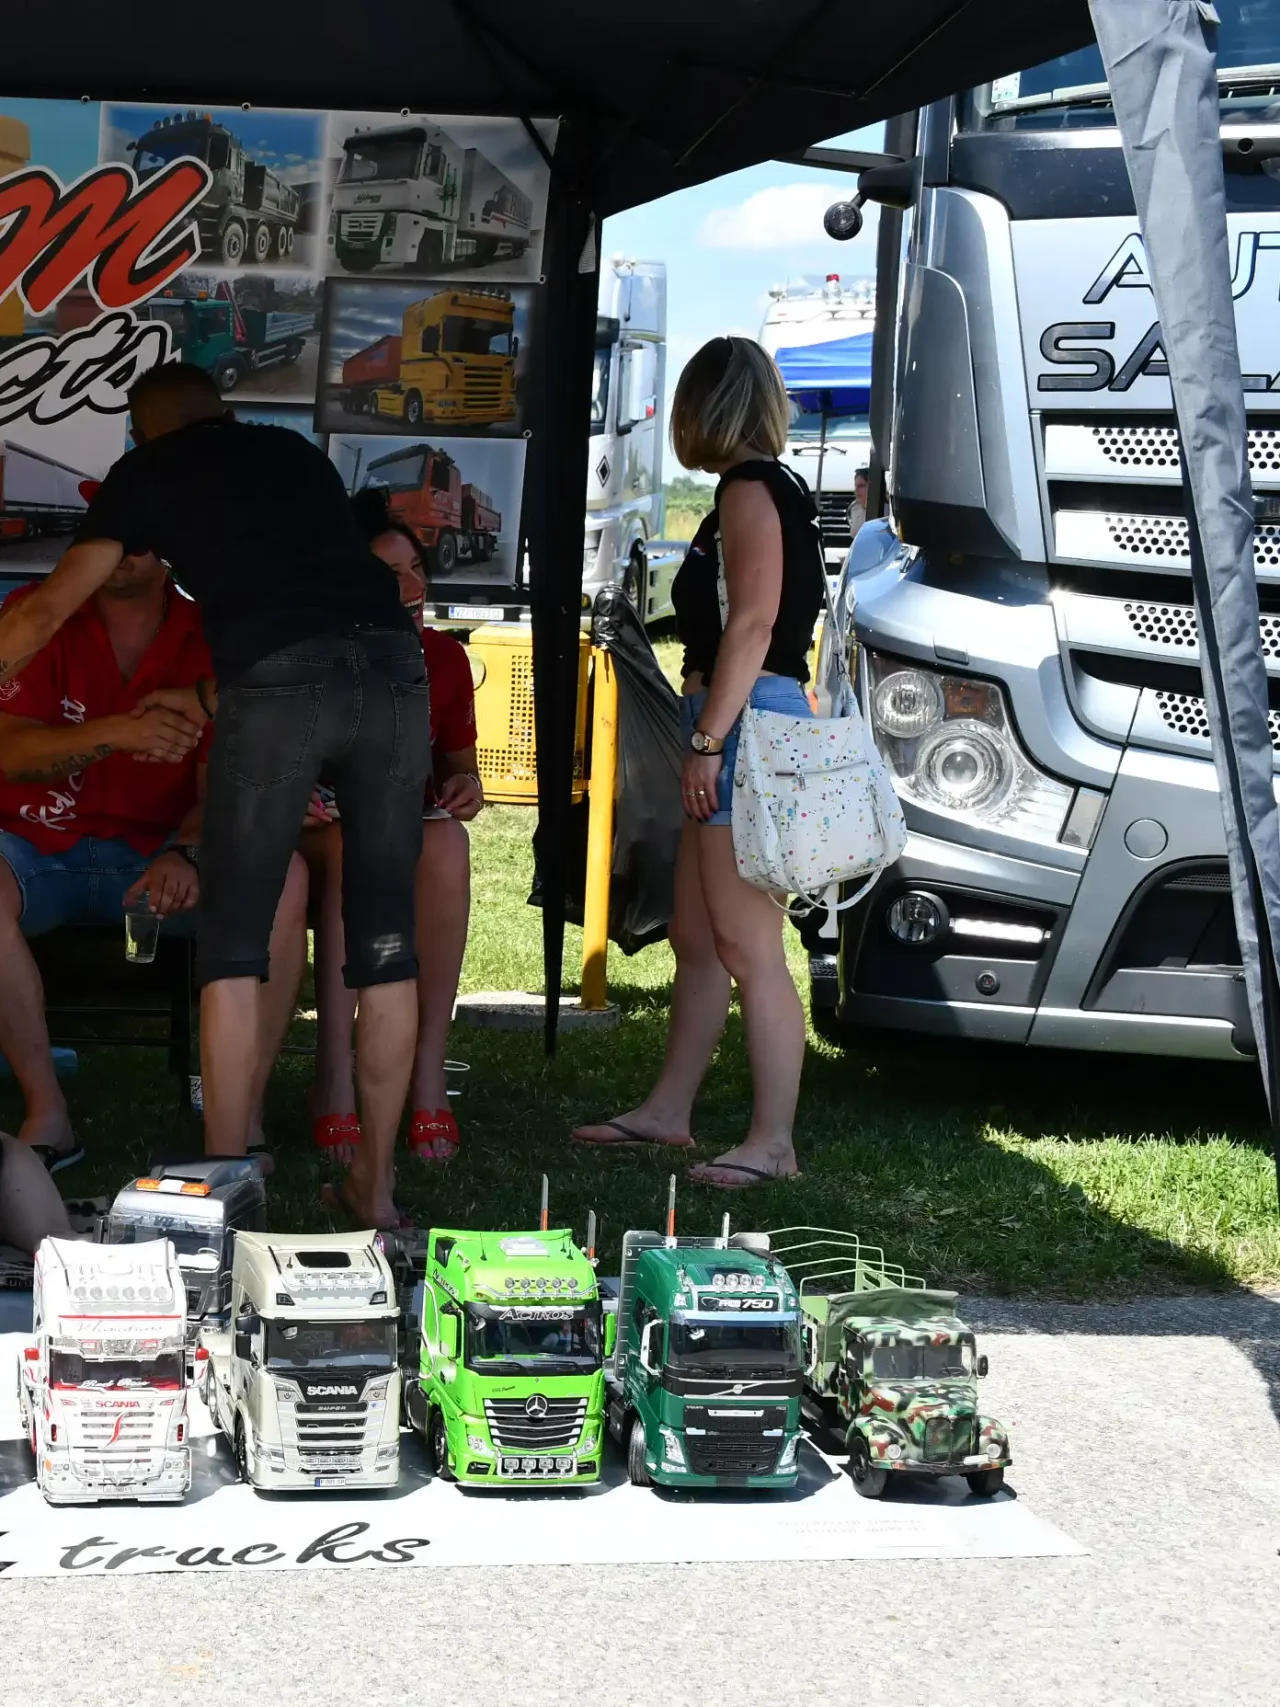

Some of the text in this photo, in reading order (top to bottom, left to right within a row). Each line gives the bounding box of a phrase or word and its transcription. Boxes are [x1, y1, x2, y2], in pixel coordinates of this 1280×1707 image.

[742, 1299, 774, 1309] 750
[307, 1385, 359, 1396] SCANIA
[95, 1400, 141, 1408] SCANIA
[59, 1521, 432, 1571] trucks
